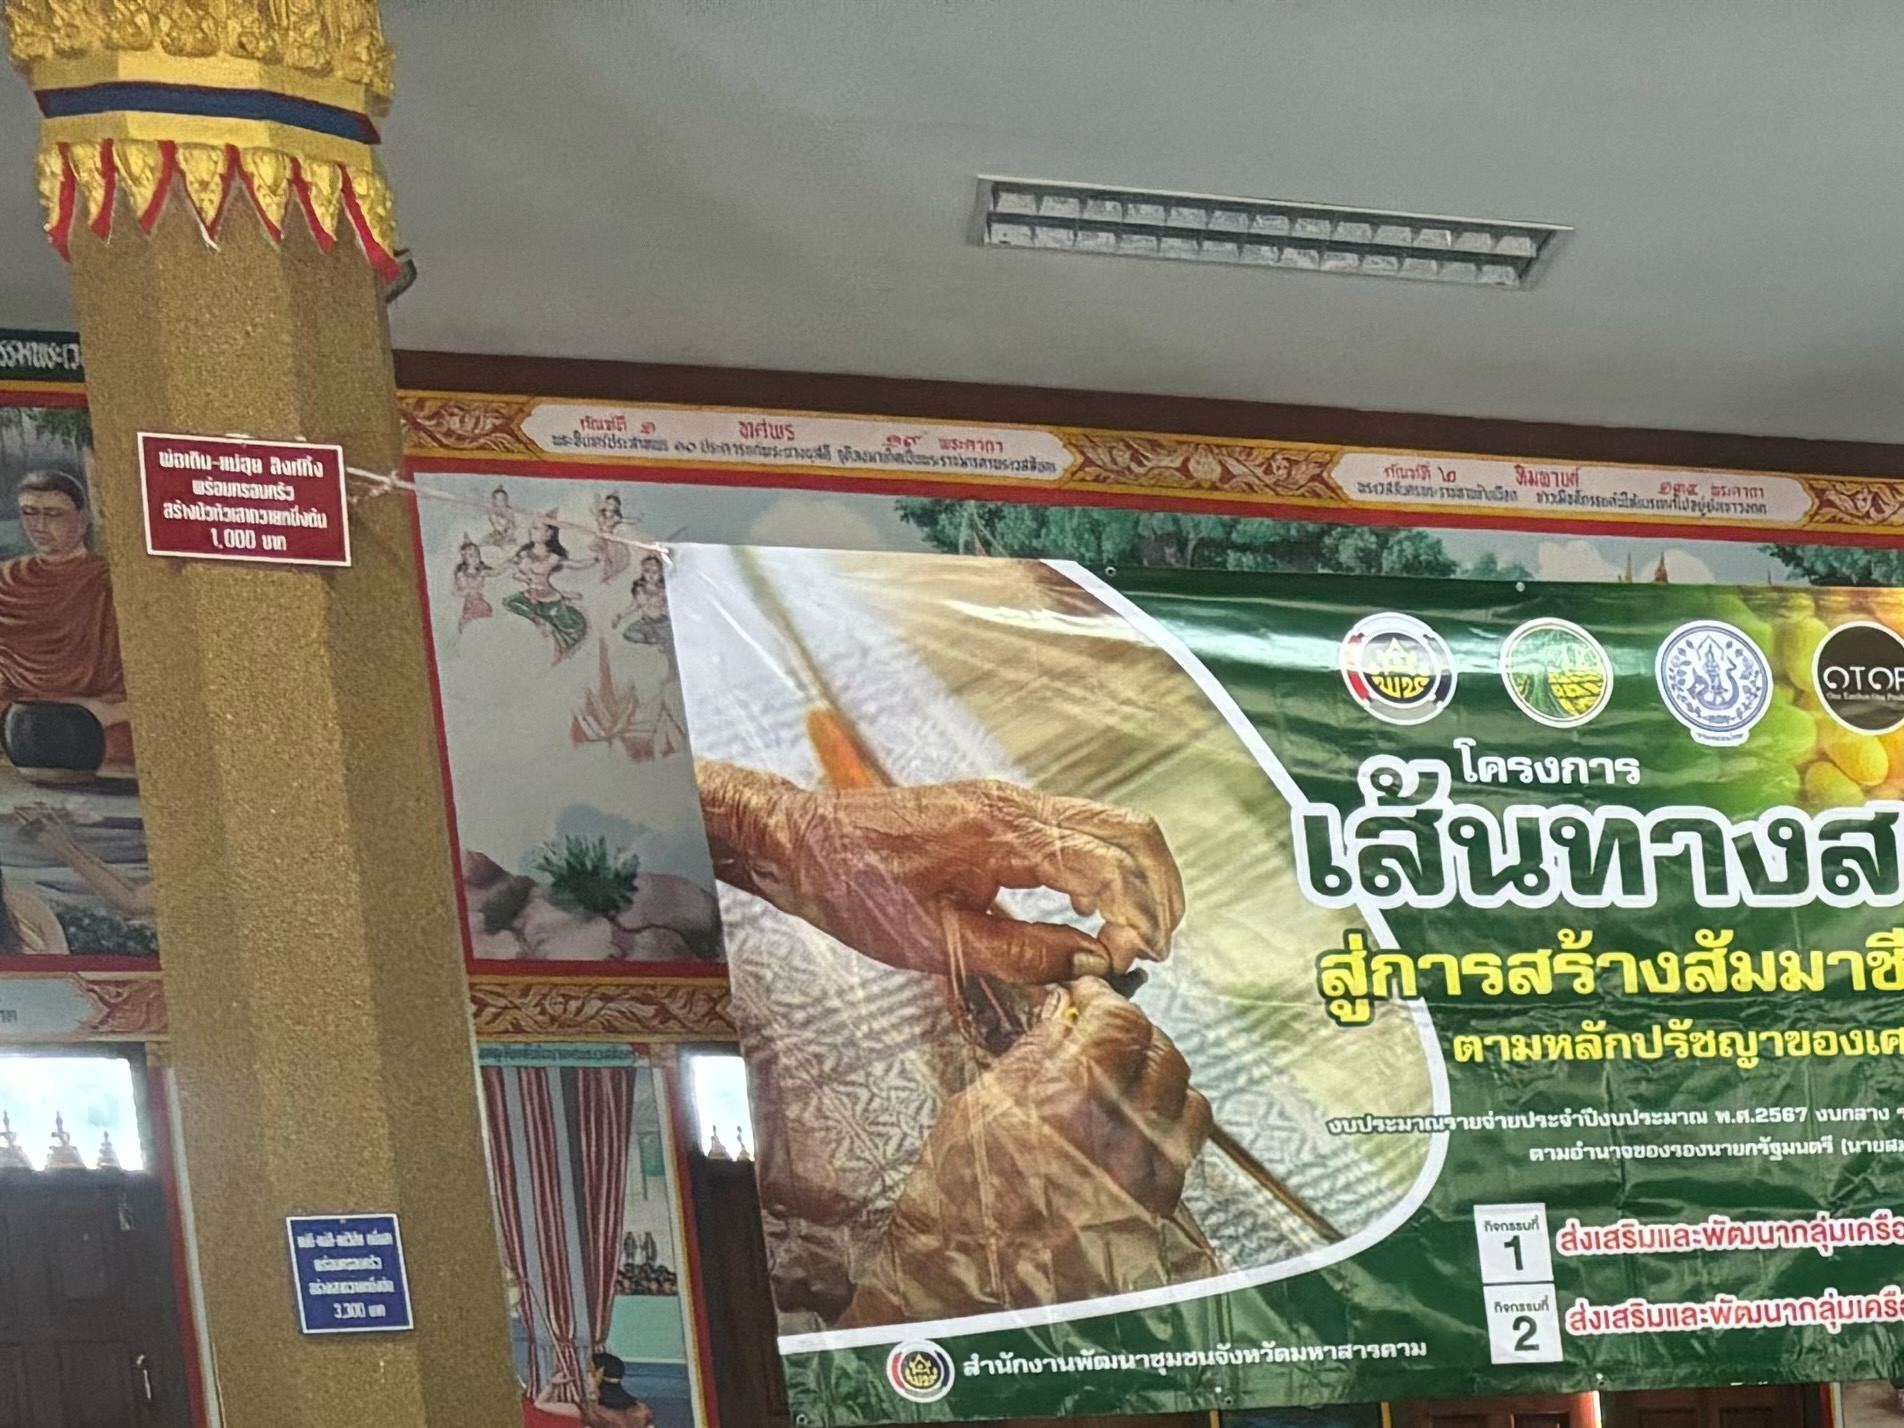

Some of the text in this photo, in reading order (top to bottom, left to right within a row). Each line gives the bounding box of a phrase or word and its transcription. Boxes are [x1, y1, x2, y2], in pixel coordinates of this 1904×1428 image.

[1454, 738, 1641, 786] โครงการ
[1328, 1106, 1707, 1135] งบประมาณรายจ่ายประจำปีงบประมาณ
[1714, 1106, 1808, 1126] พ.ศ.2567
[1816, 1103, 1890, 1122] งบกลาง
[1503, 1235, 1525, 1272] 1
[1511, 1315, 1541, 1353] 2
[962, 1339, 1428, 1378] สำนักงานพัฒนาชุมชนจังหวัดมหาสารคาม
